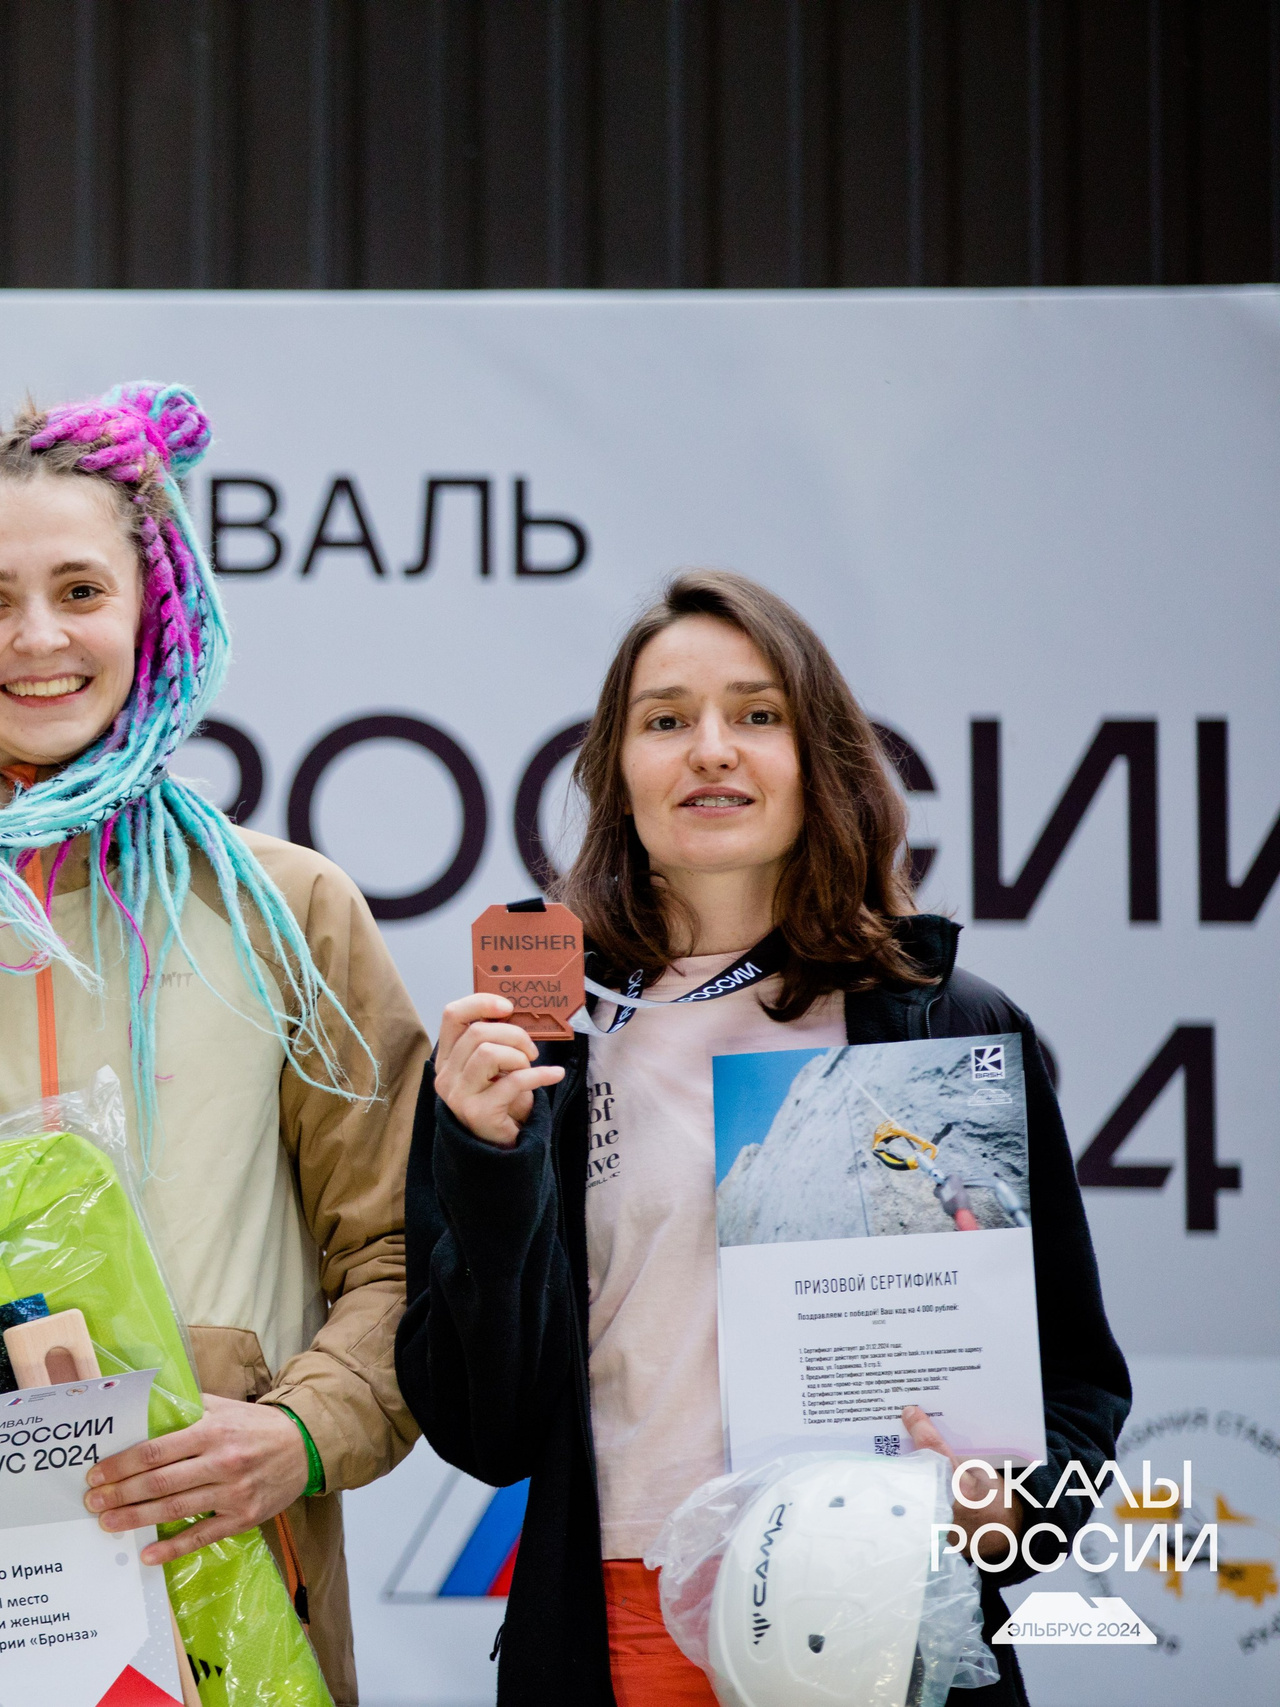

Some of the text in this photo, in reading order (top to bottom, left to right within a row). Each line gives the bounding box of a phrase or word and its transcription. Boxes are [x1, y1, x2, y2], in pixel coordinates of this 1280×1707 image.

[480, 935, 577, 951] FINISHER
[499, 980, 561, 993] СКАЛЫ
[506, 995, 568, 1009] ОССИИ
[795, 1270, 958, 1295] ПРИЗОВОЙ СЕРТИФИКАТ
[798, 1311, 842, 1321] Поздравляем
[849, 1308, 879, 1318] победой!
[880, 1307, 894, 1315] Ваш
[895, 1307, 907, 1315] код
[908, 1306, 915, 1314] на
[935, 1303, 959, 1312] рублей:
[33, 1443, 100, 1471] 2024
[753, 1504, 786, 1608] CAMP
[11, 1561, 63, 1579] Ирина
[6, 1593, 49, 1608] место
[10, 1611, 71, 1628] женщин
[30, 1629, 98, 1648] «Бронза»
